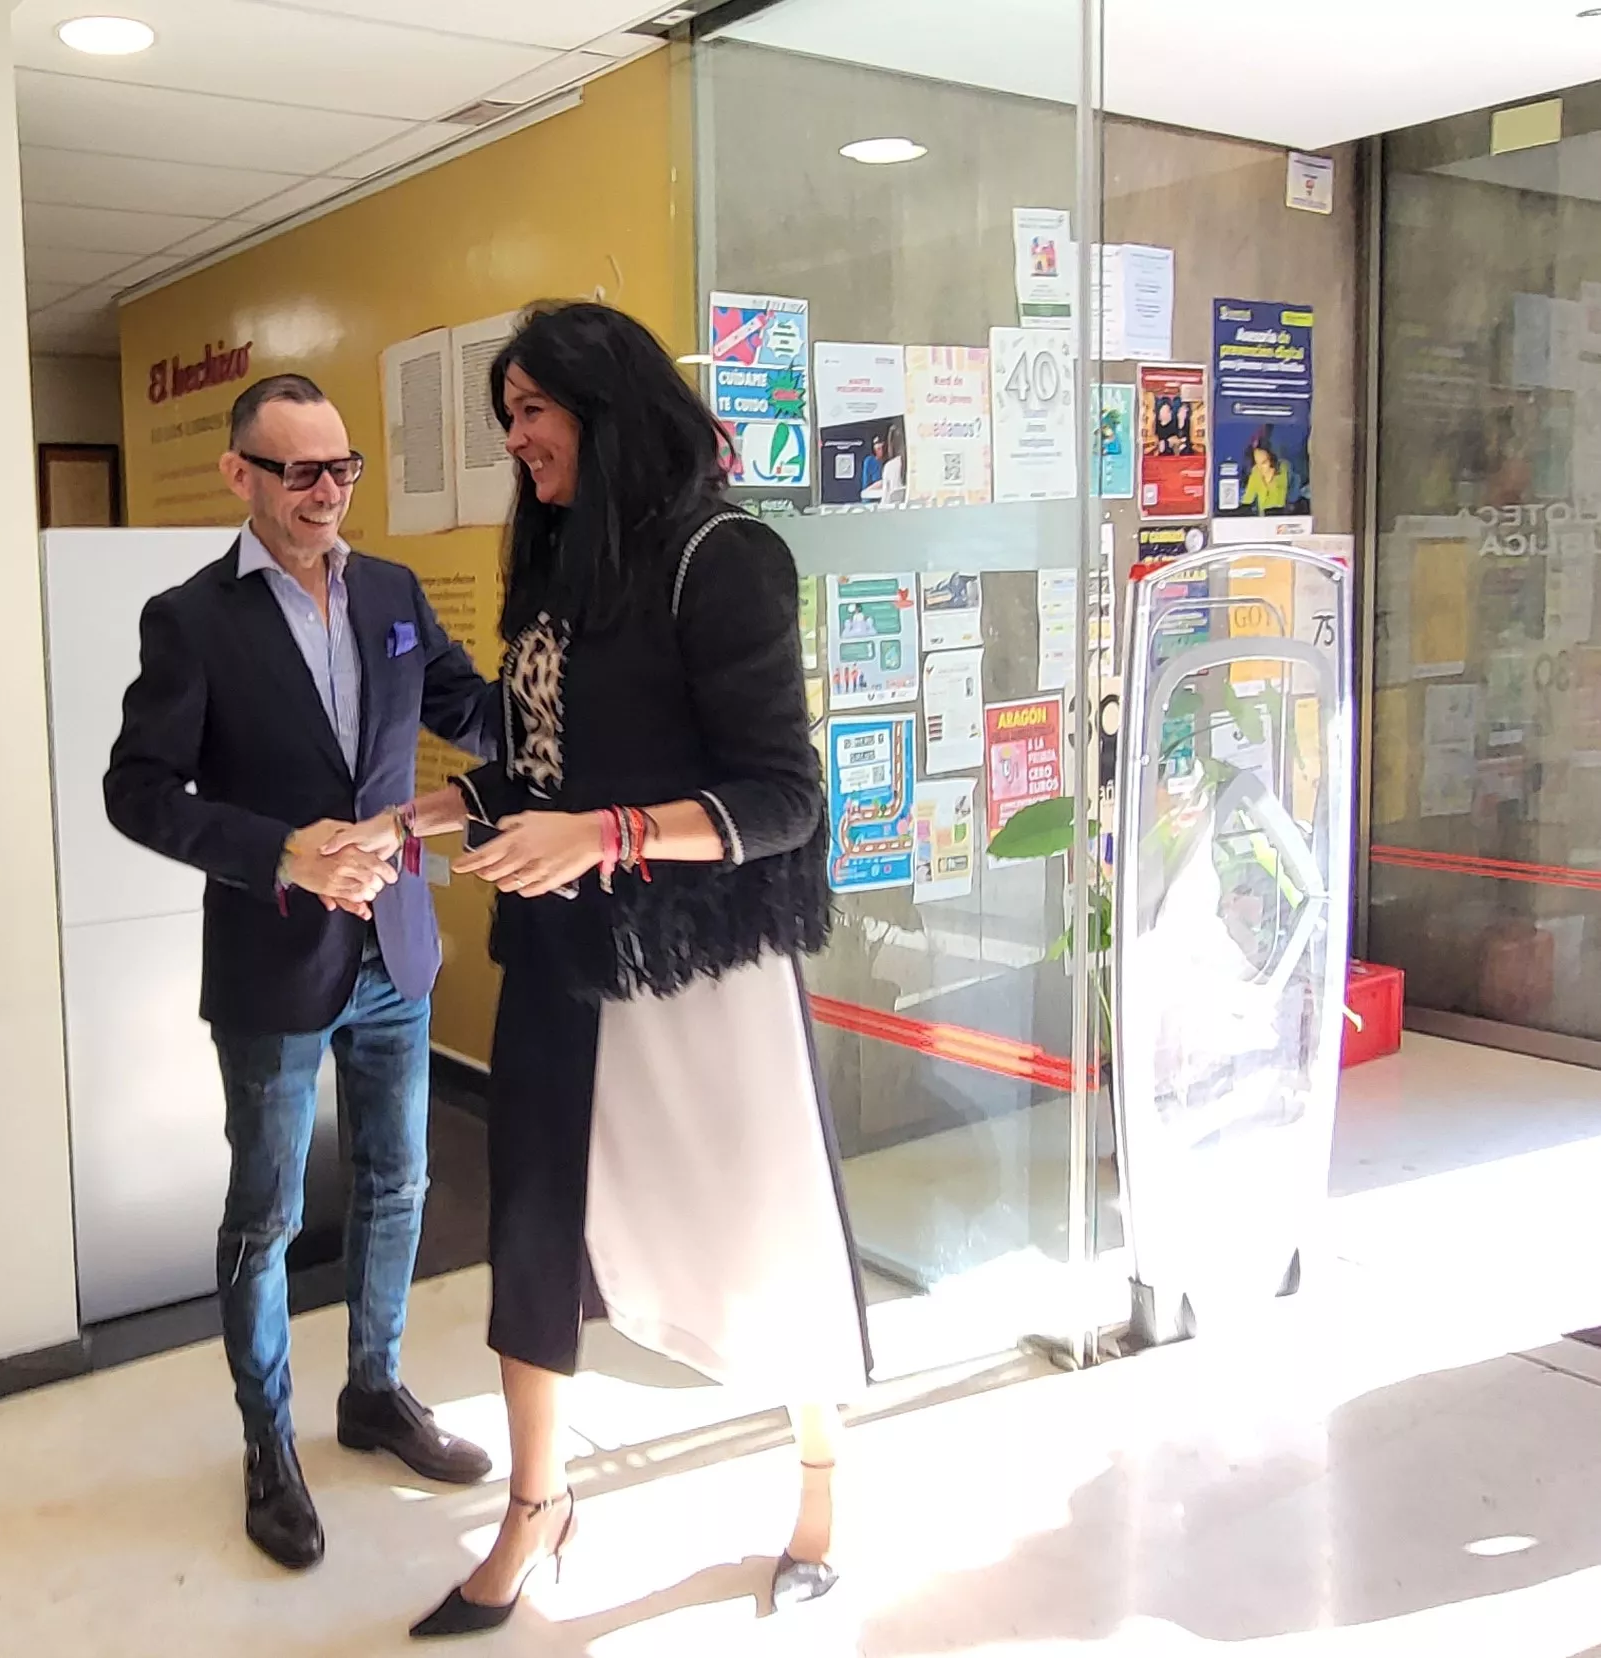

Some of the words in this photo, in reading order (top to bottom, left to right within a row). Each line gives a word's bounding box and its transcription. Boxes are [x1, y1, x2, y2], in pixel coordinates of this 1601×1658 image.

[718, 367, 769, 388] CUÍDAME
[1004, 350, 1060, 402] 40
[718, 396, 731, 413] TE
[734, 395, 770, 414] CUIDO
[1311, 612, 1337, 646] 75
[997, 705, 1048, 730] ARAGÓN
[1028, 764, 1053, 781] CERO
[1029, 776, 1059, 796] EUROS
